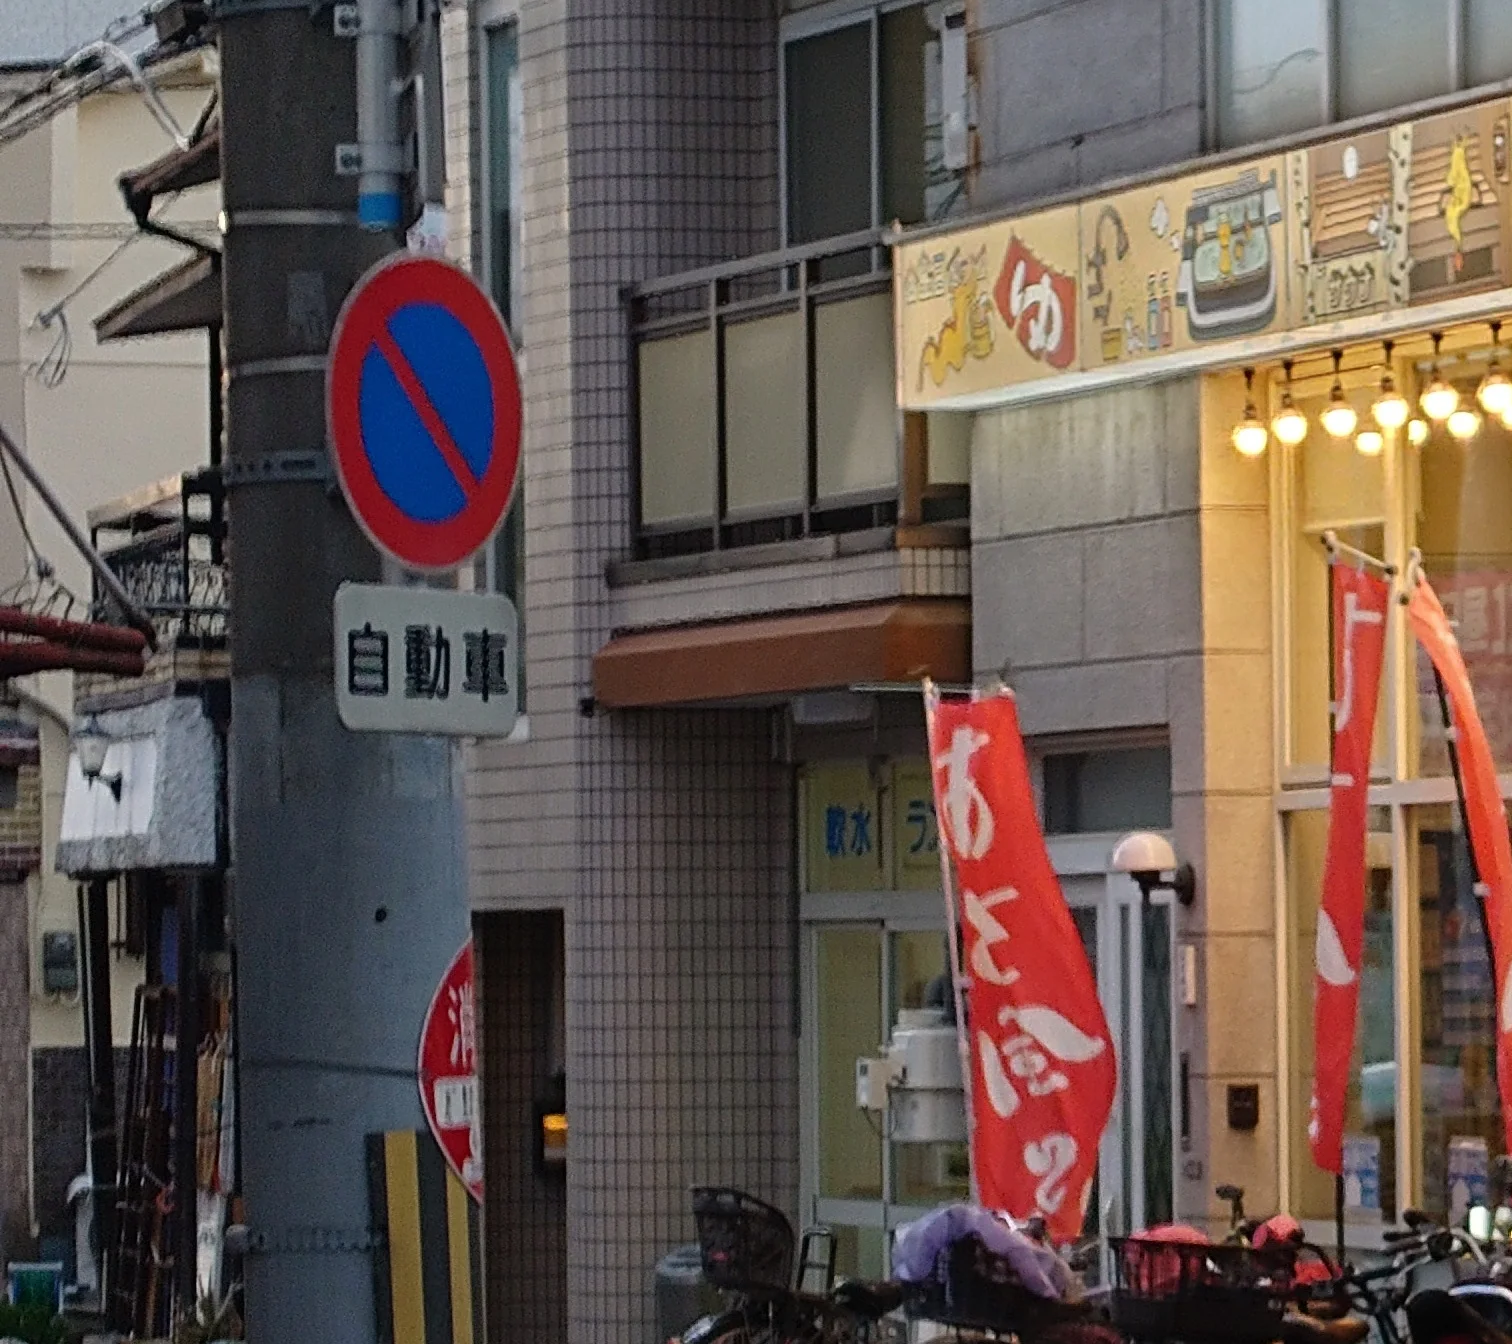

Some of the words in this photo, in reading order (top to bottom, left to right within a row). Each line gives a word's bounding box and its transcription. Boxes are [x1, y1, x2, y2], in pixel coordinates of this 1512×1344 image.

[1010, 259, 1063, 352] ゆ
[347, 622, 510, 703] 自動車
